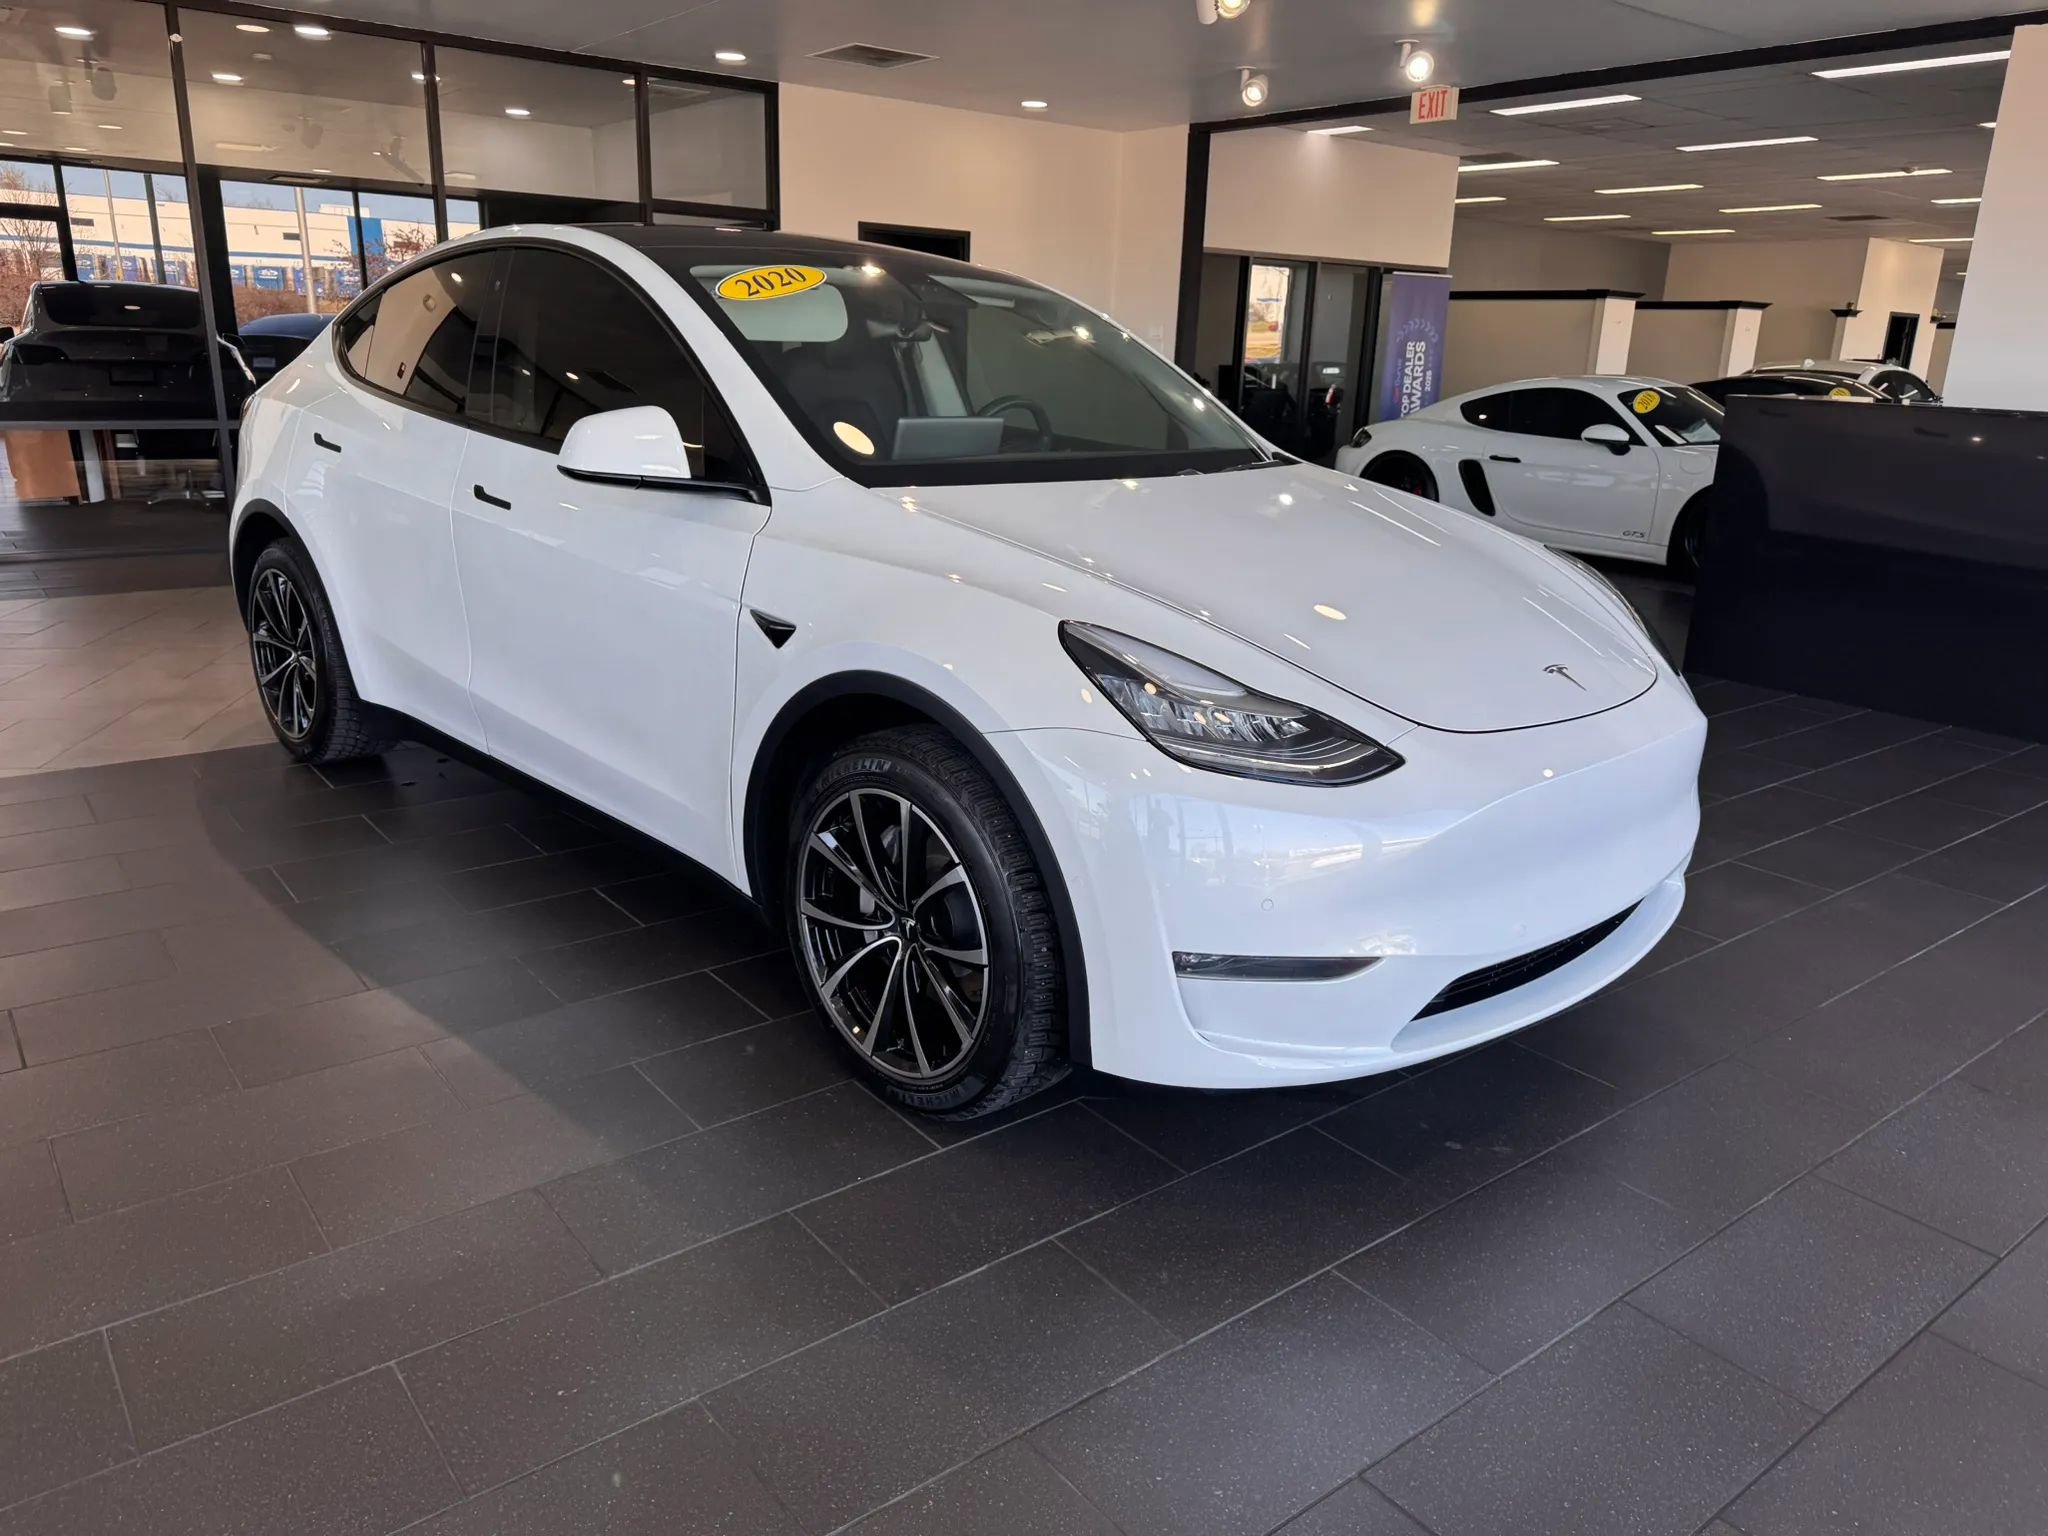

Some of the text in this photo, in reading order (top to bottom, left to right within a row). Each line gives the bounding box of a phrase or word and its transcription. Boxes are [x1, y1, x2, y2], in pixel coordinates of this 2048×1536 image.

[1418, 90, 1448, 120] EXIT
[735, 267, 807, 297] 2020
[1403, 341, 1416, 394] DEALER
